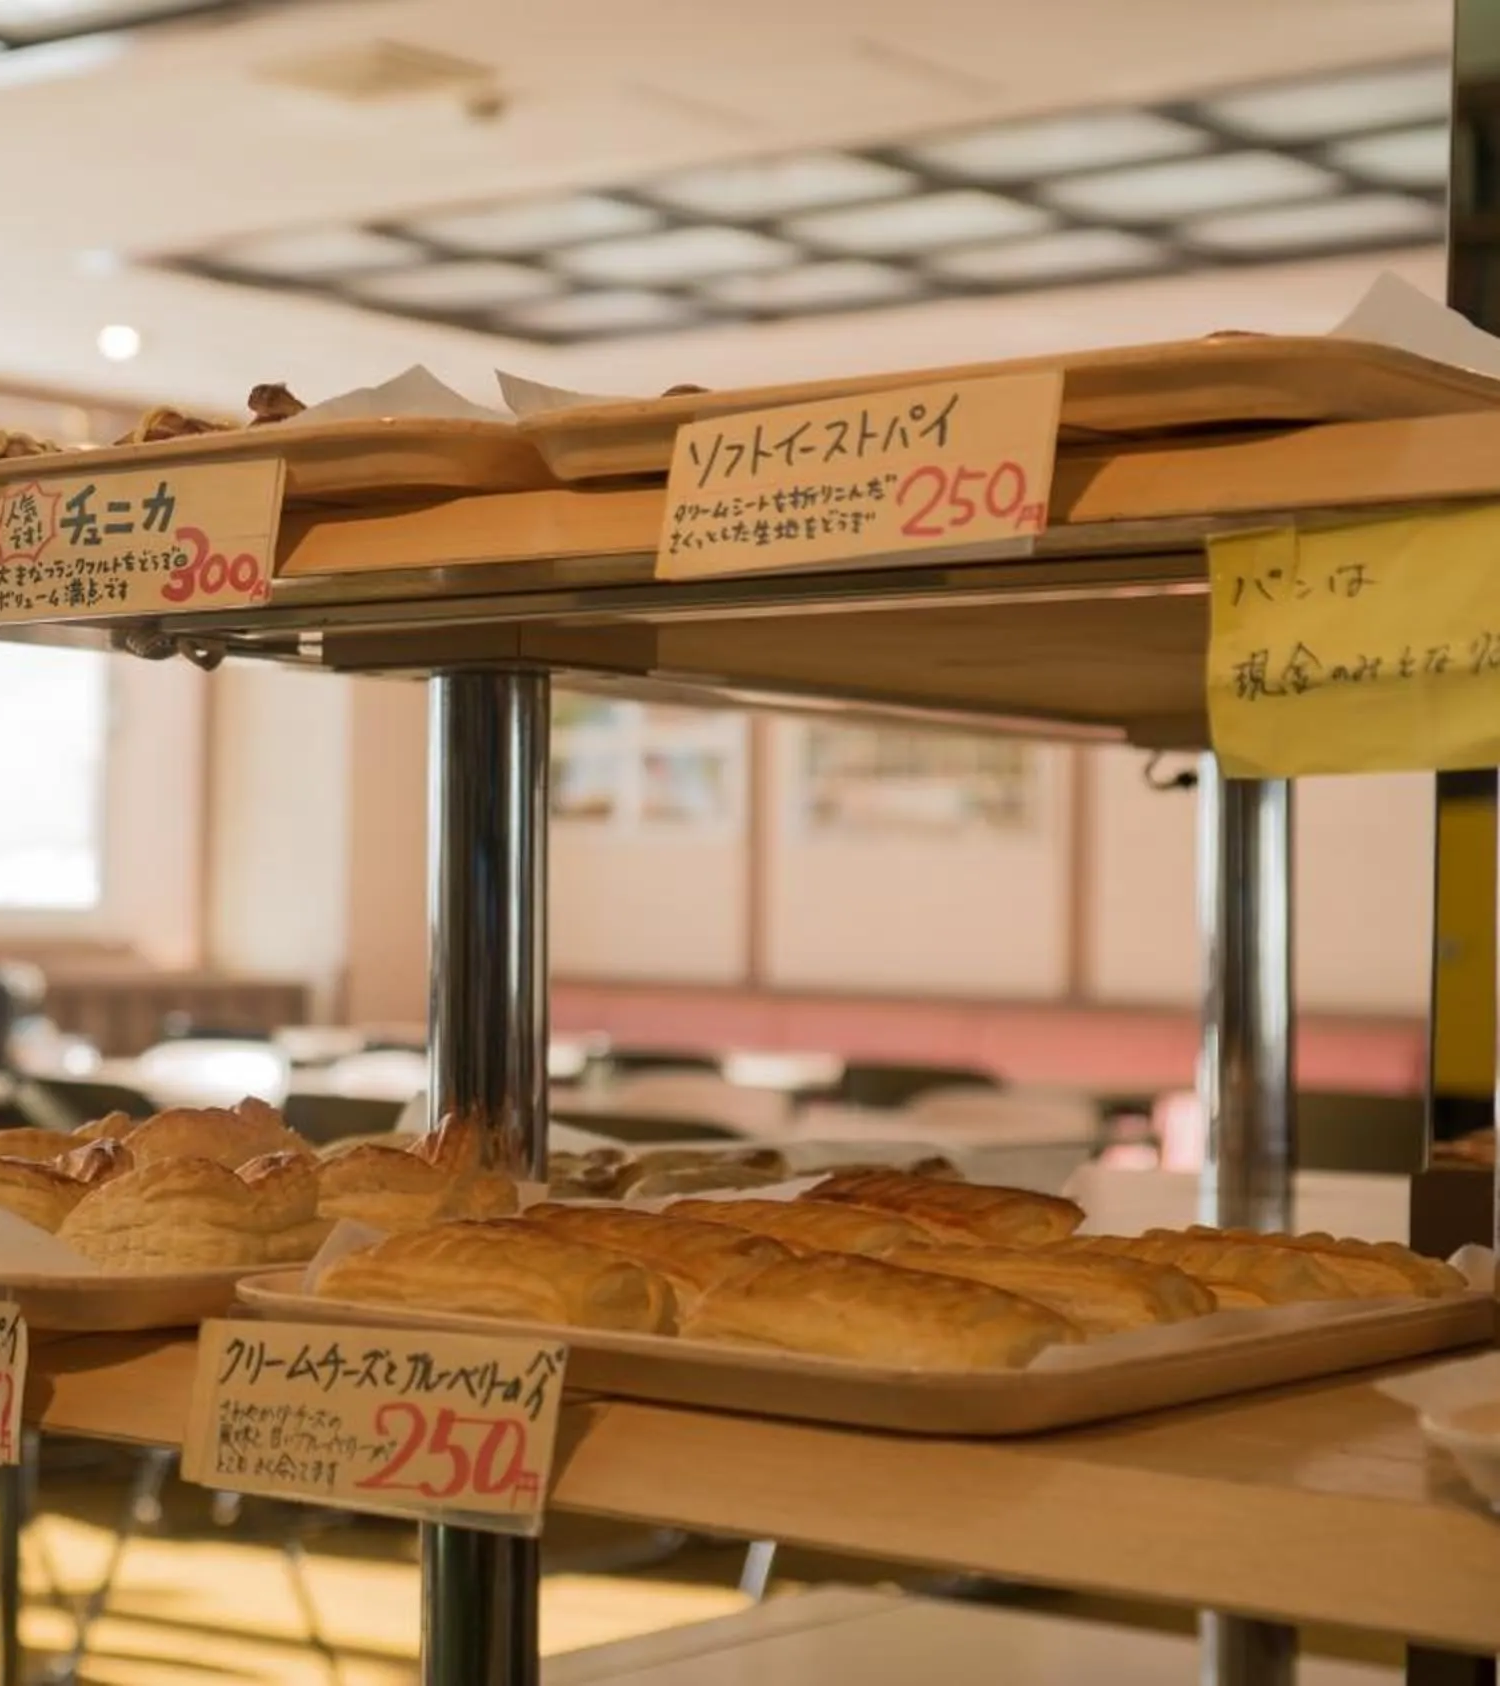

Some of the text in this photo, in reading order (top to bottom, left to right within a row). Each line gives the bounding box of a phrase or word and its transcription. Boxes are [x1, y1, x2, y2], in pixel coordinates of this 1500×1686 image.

[689, 394, 959, 489] ソフトイーストパイ
